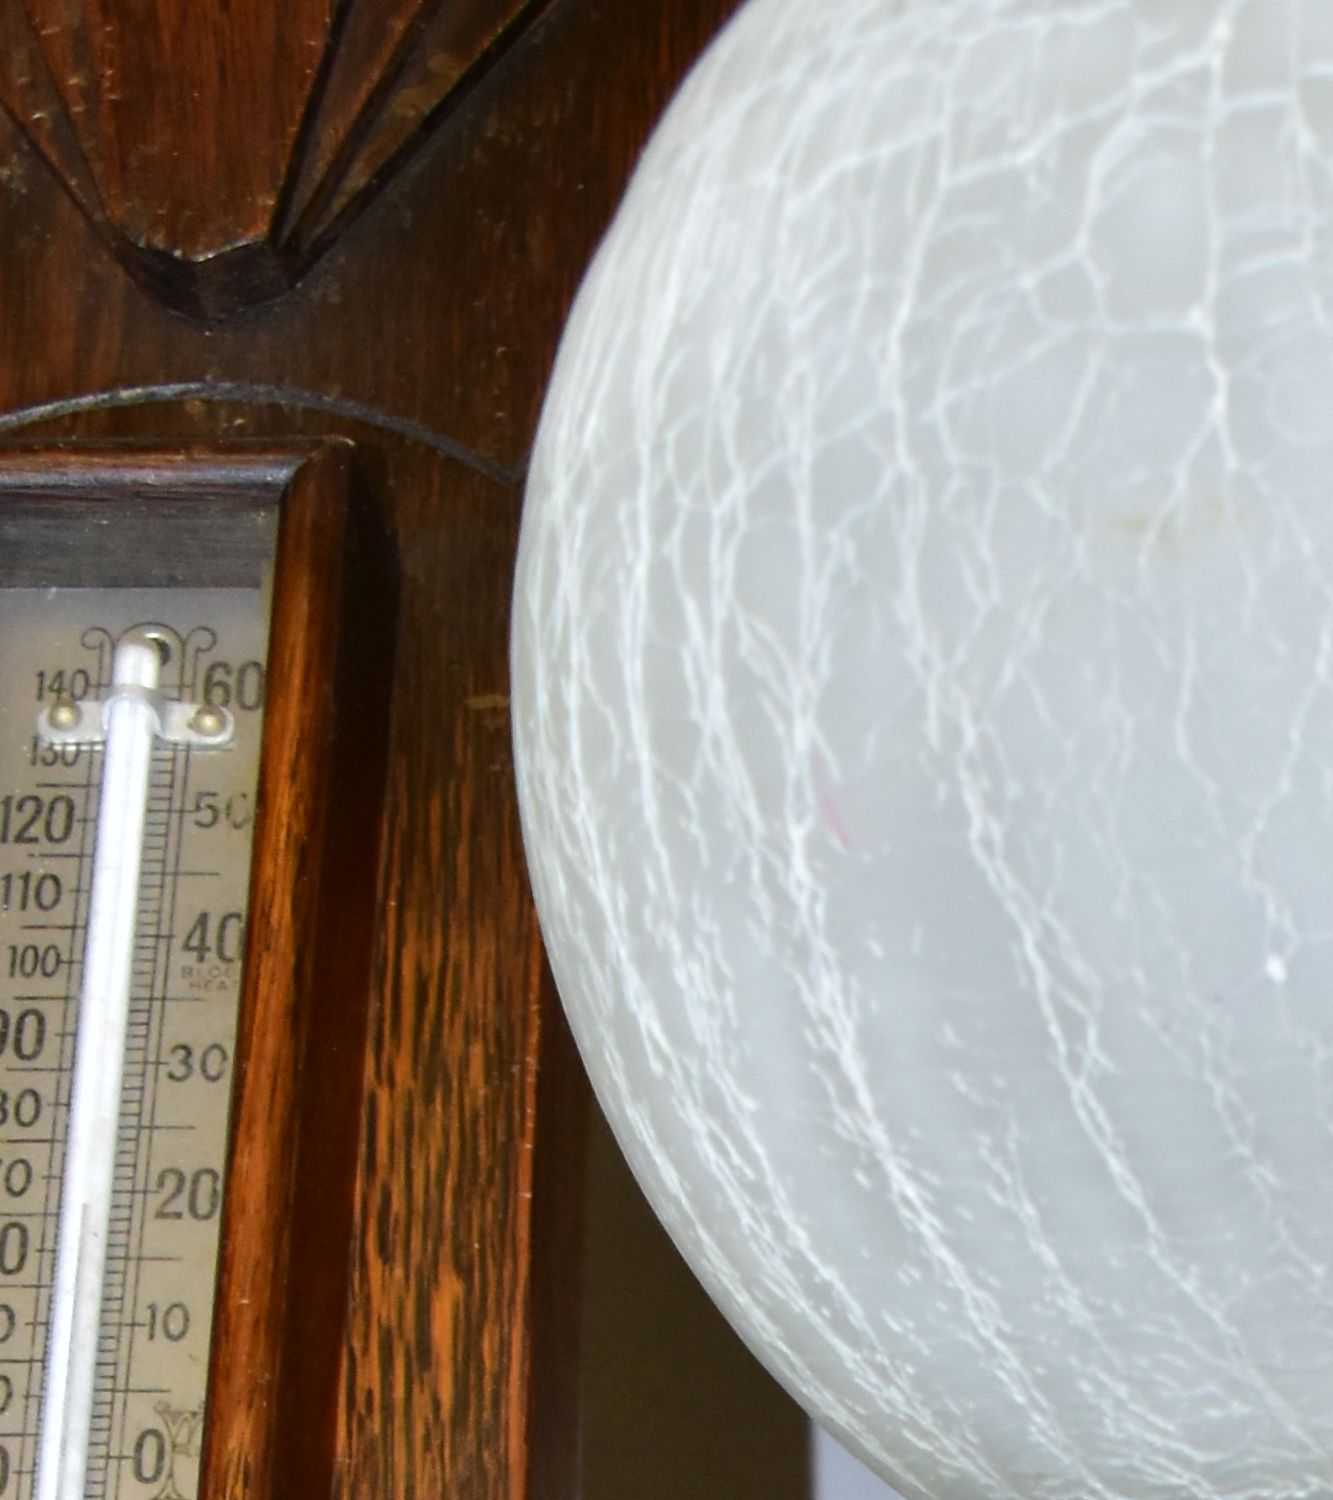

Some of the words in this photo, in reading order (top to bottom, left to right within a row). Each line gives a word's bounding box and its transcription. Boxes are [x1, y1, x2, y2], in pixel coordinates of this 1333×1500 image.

[35, 669, 90, 701] 140
[204, 660, 265, 711] 60
[0, 795, 76, 845] 120
[195, 792, 252, 830] 50
[0, 871, 62, 911] 110
[182, 912, 243, 965] 40
[8, 944, 62, 979] 100
[167, 1042, 228, 1083] 30
[155, 1168, 220, 1221] 20
[145, 1302, 189, 1342] 10
[133, 1428, 166, 1484] 0
